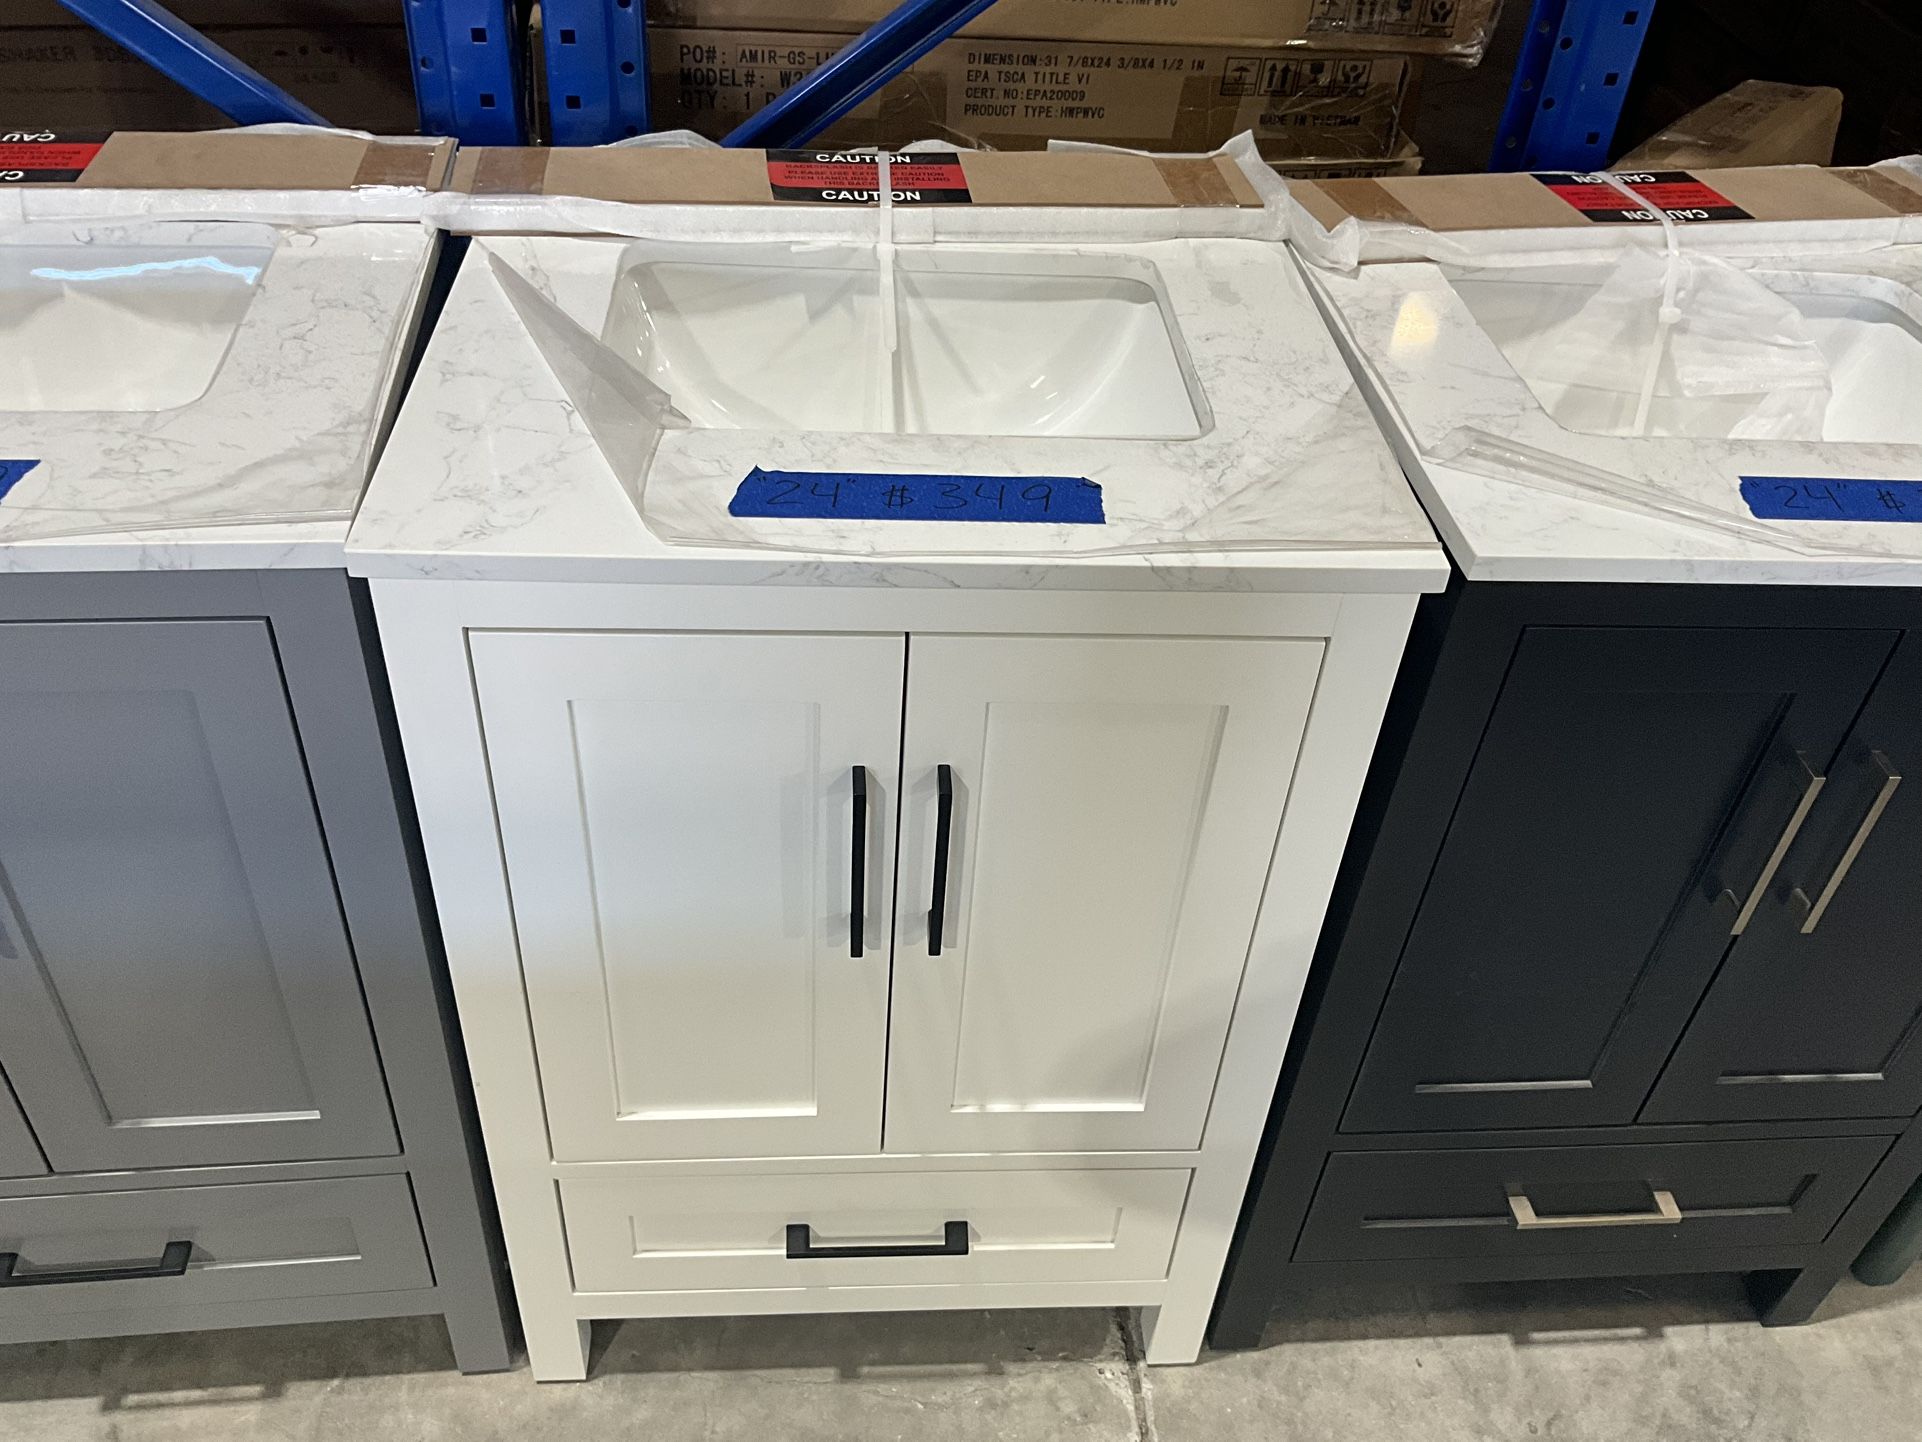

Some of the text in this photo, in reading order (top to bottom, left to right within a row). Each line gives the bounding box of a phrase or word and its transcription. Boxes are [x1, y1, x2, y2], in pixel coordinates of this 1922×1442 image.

[679, 44, 727, 65] PO#:
[1162, 57, 1184, 71] 1/2
[1190, 59, 1206, 72] IN
[679, 67, 765, 88] MODEL#:
[966, 69, 1091, 86] EPA TSCA TITLE VI
[744, 91, 750, 110] 1
[964, 103, 1015, 117] PRODUCT
[1293, 114, 1306, 126] IN
[1, 133, 56, 142] CAU
[1571, 174, 1656, 184] CAUON
[821, 190, 922, 201] CAUTON
[1620, 209, 1710, 221] CAUON
